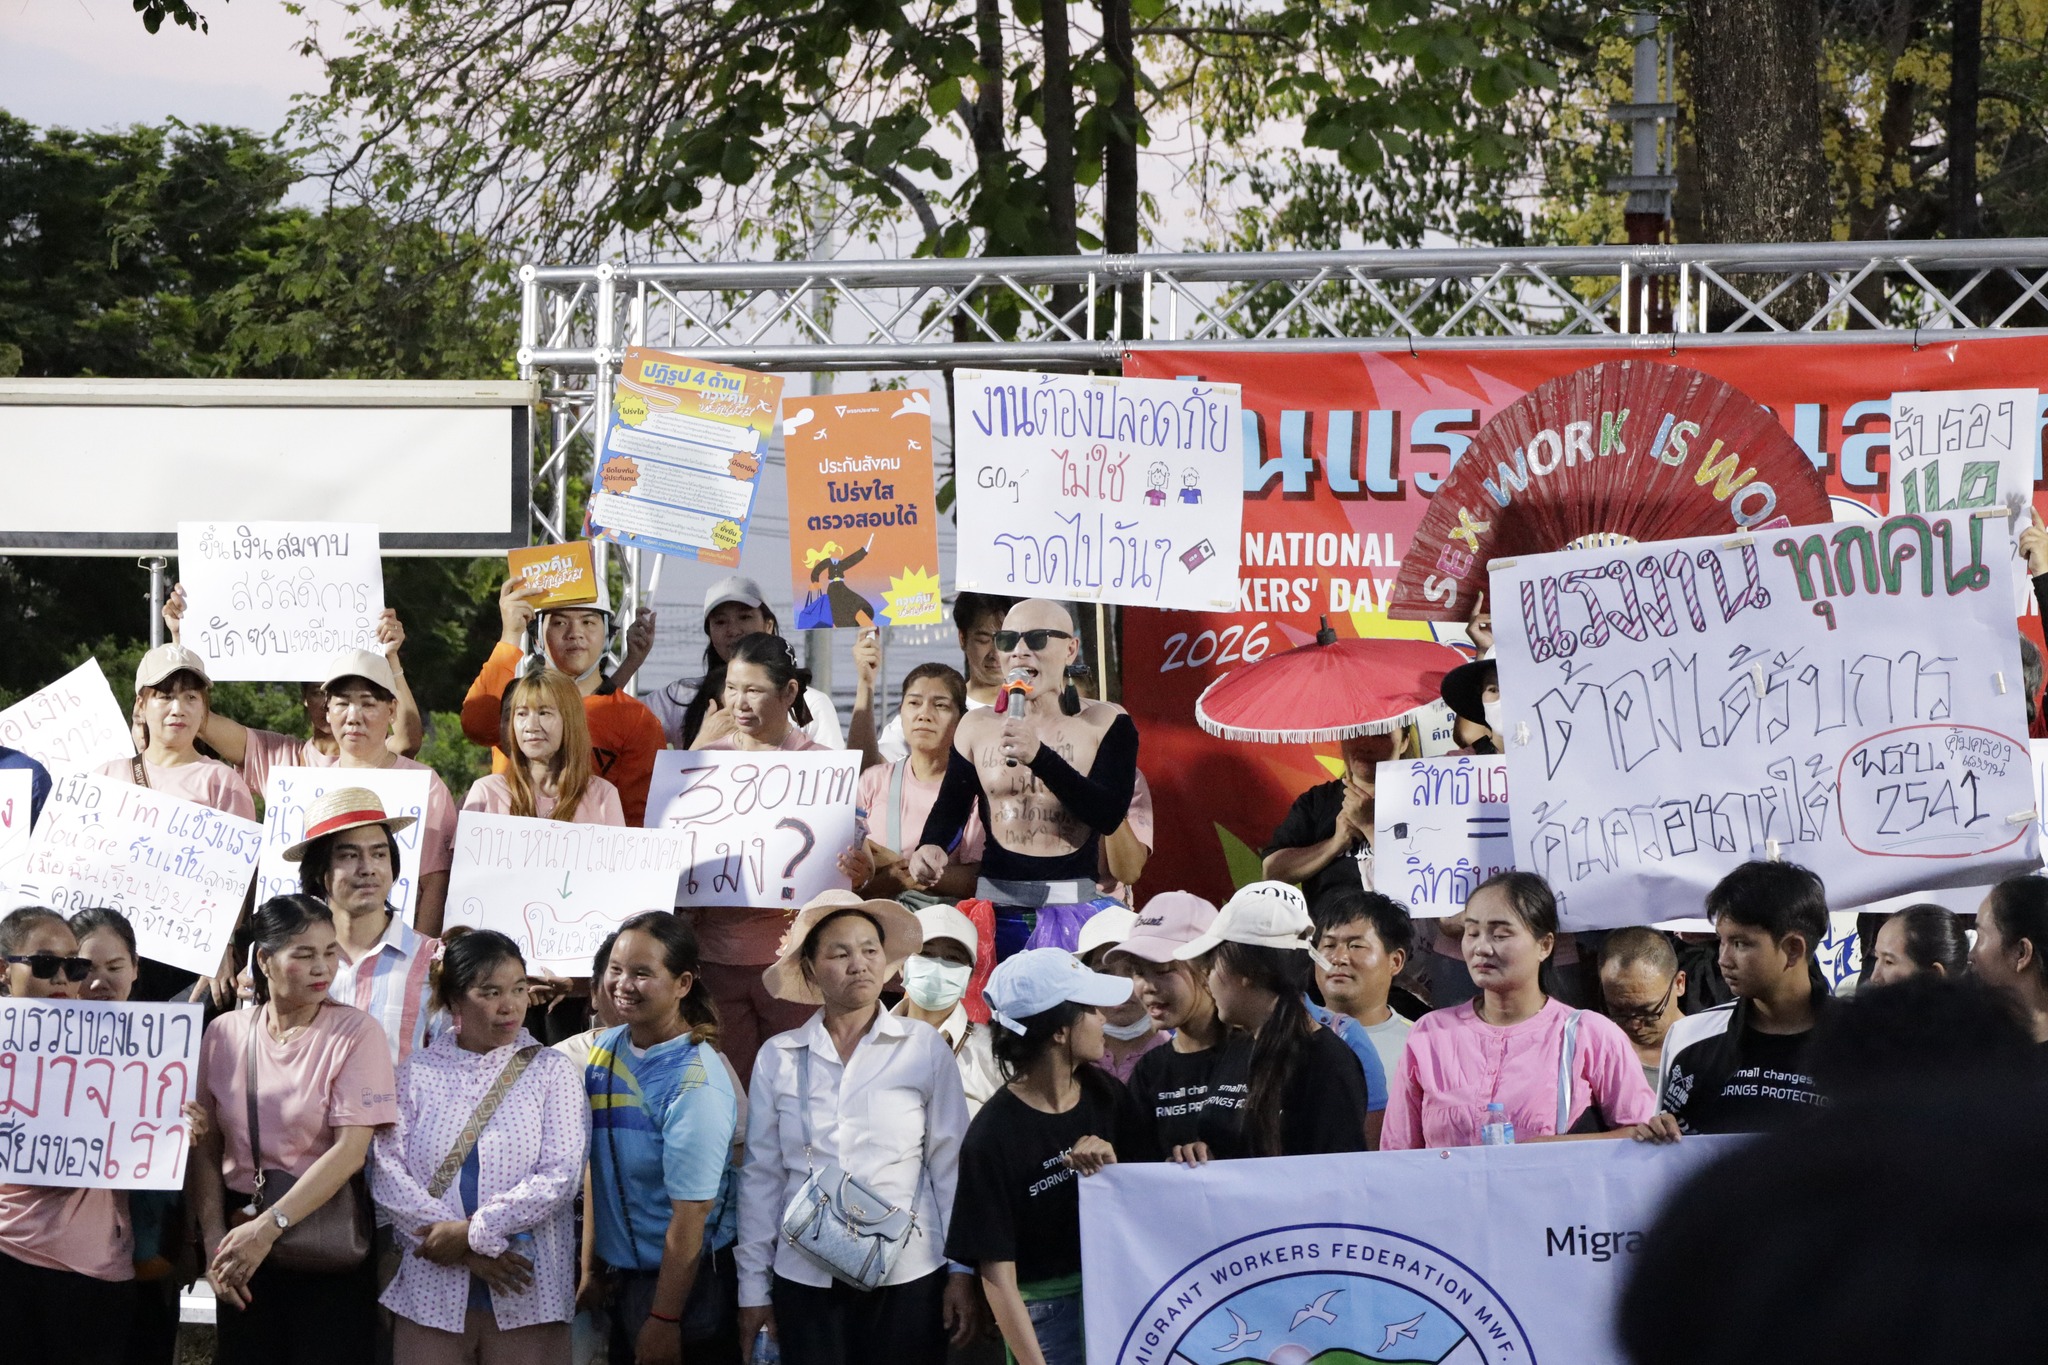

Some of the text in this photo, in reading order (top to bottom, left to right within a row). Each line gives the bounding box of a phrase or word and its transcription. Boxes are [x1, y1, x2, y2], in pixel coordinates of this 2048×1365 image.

[643, 363, 741, 391] ปฏิรูป 4 ด้าน
[972, 374, 1228, 453] งานต้องปลอดภัย
[818, 454, 901, 475] ประกันสังคม
[827, 478, 895, 503] โปร่งใส
[1423, 506, 1490, 609] SEX
[1482, 408, 1631, 508] WORK
[1649, 411, 1700, 467] IS
[807, 503, 918, 531] ตรวจสอบได้
[1240, 531, 1400, 568] NATIONAL
[1237, 576, 1393, 613] KERS' DAY
[1519, 511, 1991, 665] แรงงาน ทุกคน
[1160, 621, 1271, 673] 2026
[1531, 643, 1958, 781] ต้องได้รับการ
[1411, 757, 1509, 807] สิทธิแร
[1876, 769, 1991, 835] 2541
[0, 1006, 193, 1059] มรวยของเขา
[1734, 1067, 1760, 1079] mall
[1156, 1104, 1188, 1118] RNGS
[1760, 1085, 1831, 1108] PROTECTIO
[1209, 1243, 1320, 1286] WORKERS
[1331, 1242, 1474, 1306] FEDERATION
[1473, 1305, 1515, 1362] MWF.
